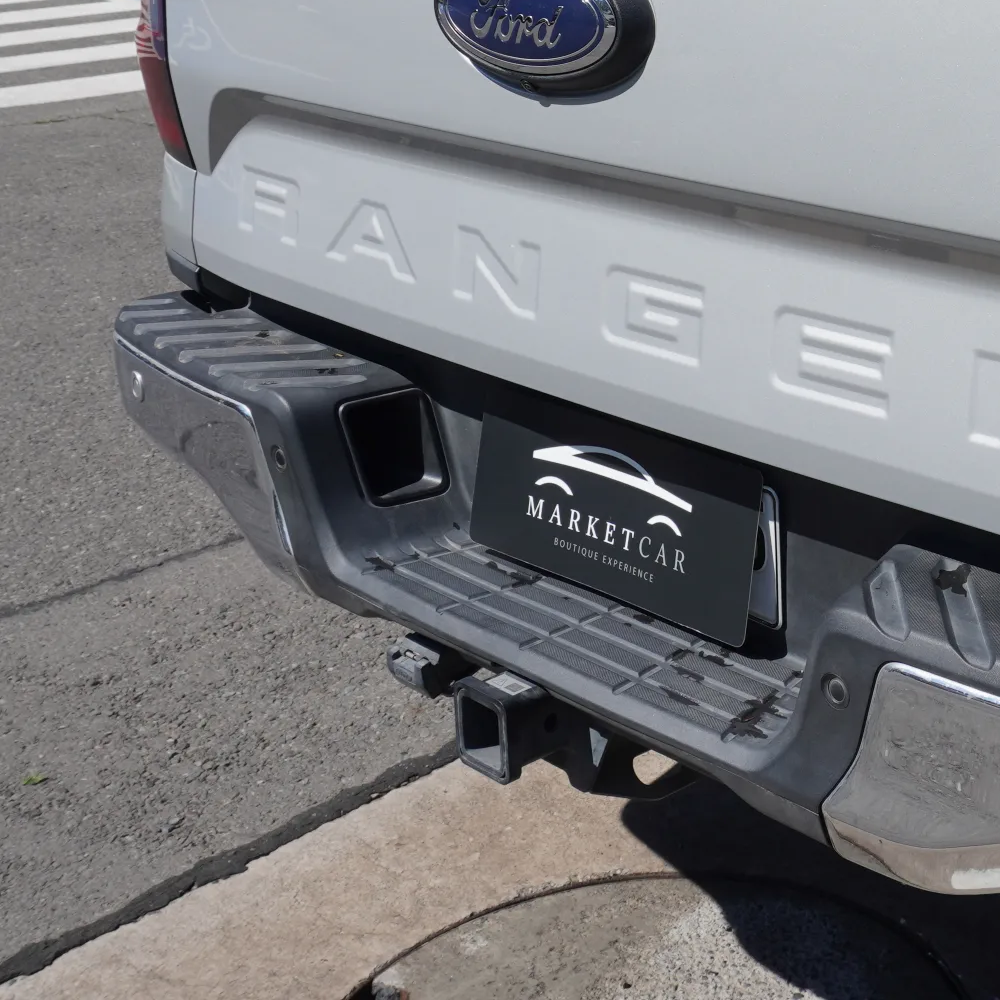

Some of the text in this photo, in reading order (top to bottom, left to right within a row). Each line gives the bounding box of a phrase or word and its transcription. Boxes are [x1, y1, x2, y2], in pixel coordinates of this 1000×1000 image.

[526, 494, 686, 574] MARKETCAR
[553, 536, 655, 583] BOUTIQUE EXPERIENCE
